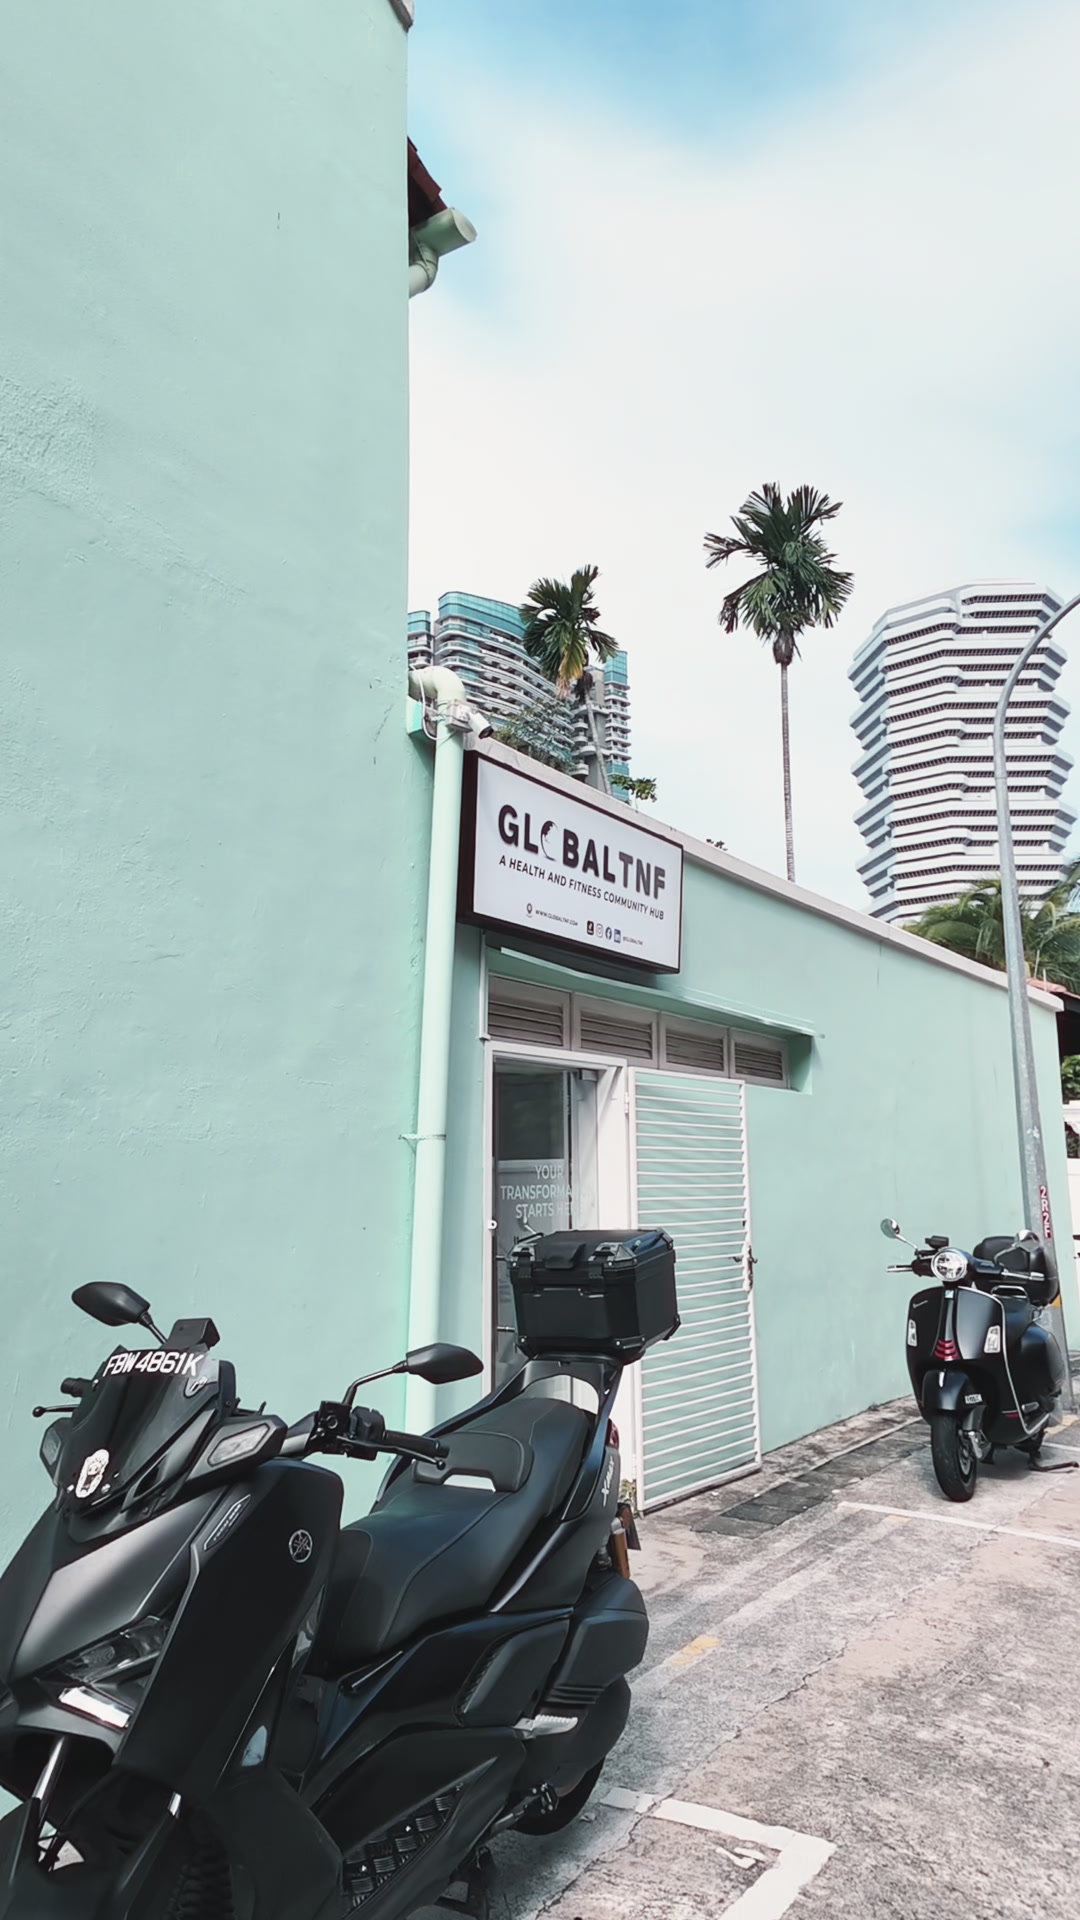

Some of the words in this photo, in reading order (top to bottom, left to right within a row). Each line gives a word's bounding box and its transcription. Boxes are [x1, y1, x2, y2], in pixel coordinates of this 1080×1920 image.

[499, 855, 506, 866] A
[509, 858, 546, 879] HEALTH
[547, 872, 567, 886] AND
[568, 879, 602, 899] FITNESS
[603, 891, 648, 914] COMMUNITY
[649, 907, 665, 920] HUB
[535, 1165, 564, 1179] YOUR
[501, 1184, 588, 1200] TRANSFORMA
[516, 1203, 554, 1218] STARTS
[102, 1351, 205, 1377] FBW4861K
